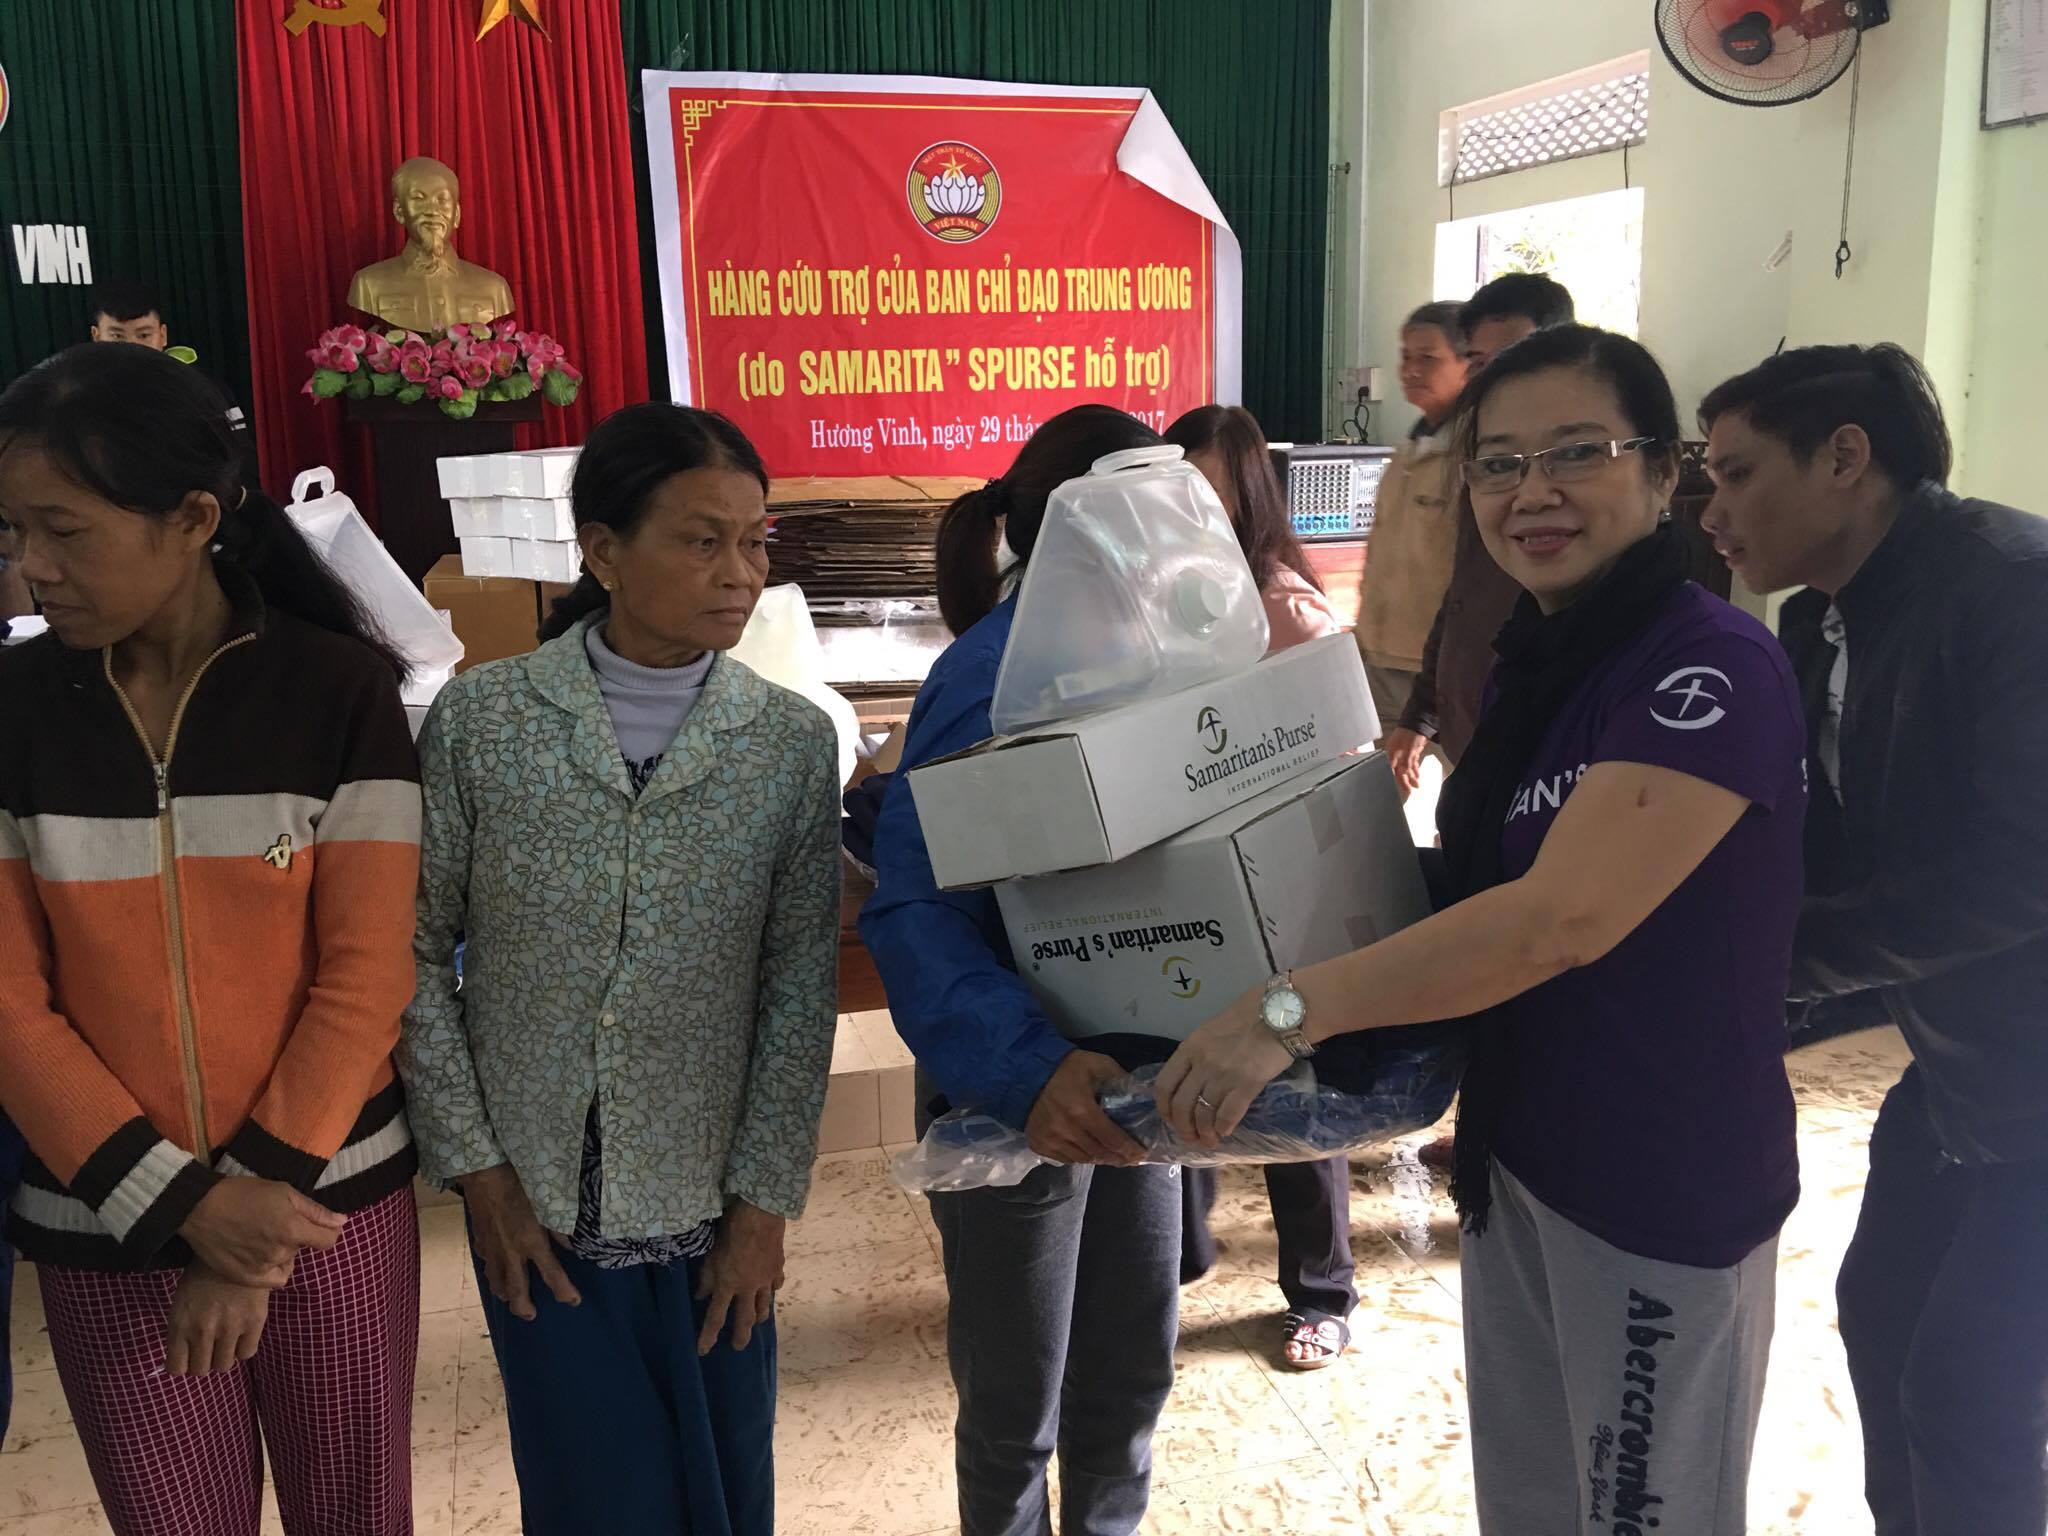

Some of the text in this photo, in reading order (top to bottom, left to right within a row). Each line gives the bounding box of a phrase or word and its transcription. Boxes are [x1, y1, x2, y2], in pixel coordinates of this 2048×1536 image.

[957, 219, 979, 231] NAM
[12, 224, 93, 285] VINH
[707, 253, 1192, 325] HÀNG CỨU TRỢ CỦA BAN CHỈ ĐẠO TRUNG ƯƠNG
[738, 351, 785, 401] (do
[968, 346, 1077, 392] SPURSE
[1085, 336, 1117, 389] hỗ
[1125, 344, 1170, 395] trợ)
[810, 419, 873, 453] Hương
[877, 416, 927, 450] Vinh,
[931, 416, 975, 450] ngày
[980, 415, 1001, 443] 29
[1128, 410, 1165, 437] 017
[1184, 720, 1317, 792] Samaritan's Purse
[1227, 748, 1319, 795] INTERNATIONAL RELIEF
[1024, 908, 1163, 933] INTERNATIONAL RELIEF
[1031, 919, 1224, 961] Samaritan's Purse
